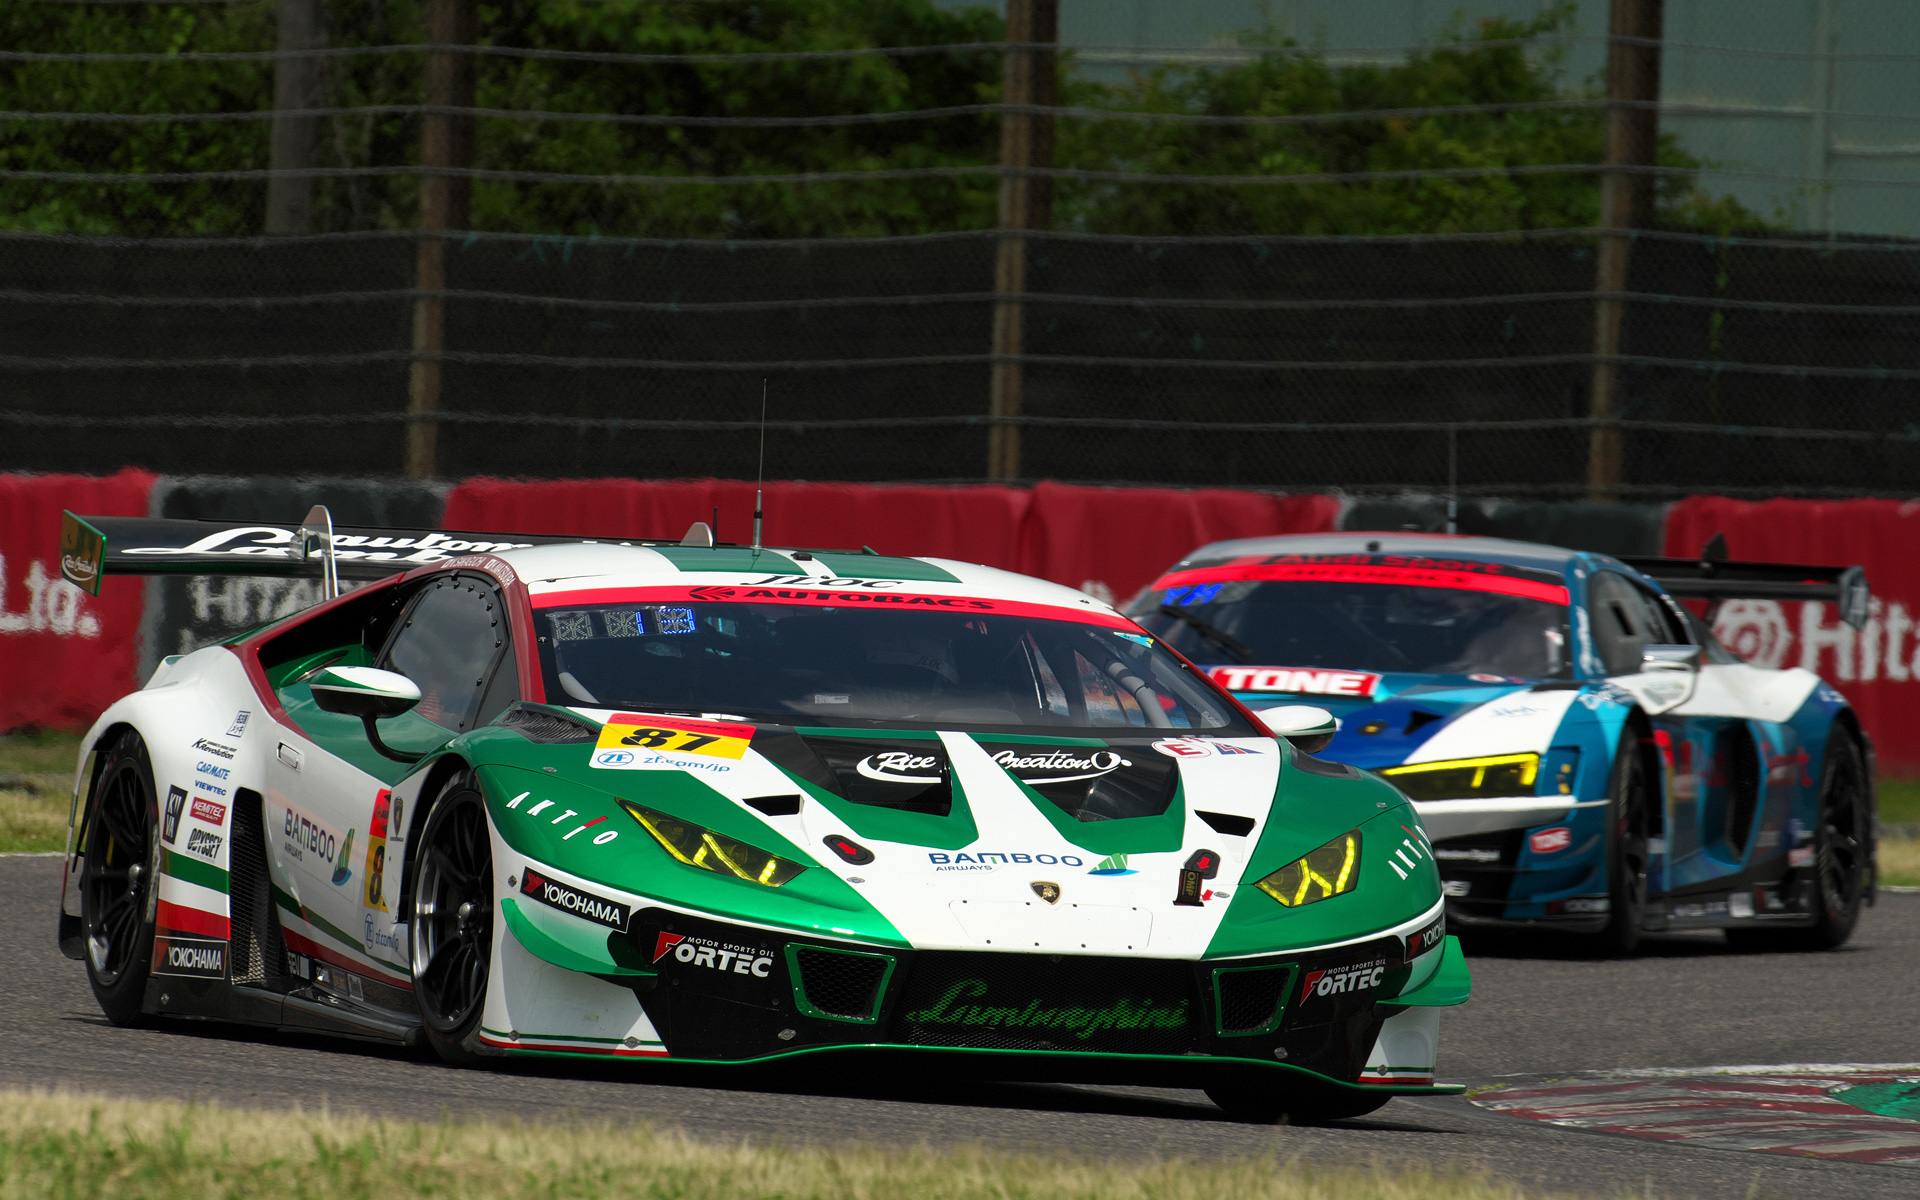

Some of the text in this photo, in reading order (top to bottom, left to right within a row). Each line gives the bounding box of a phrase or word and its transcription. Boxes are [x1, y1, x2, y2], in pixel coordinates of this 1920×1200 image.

[740, 575, 903, 588] JLOC
[743, 590, 996, 610] AUTOBACS
[1222, 668, 1366, 696] TONE
[620, 728, 721, 752] 87
[196, 761, 231, 780] CARMATE
[643, 755, 731, 773] zf.com/jp
[877, 750, 1093, 773] Rice Creation
[194, 780, 227, 796] VIEWTEC
[193, 800, 225, 818] KEMITEC
[506, 791, 619, 845] AKTIO
[187, 828, 223, 860] ODYSSEY
[284, 807, 335, 864] BAMBOO
[928, 852, 1084, 867] BAMBOO
[1186, 871, 1197, 897] OMP
[543, 882, 621, 925] YOKOHAMA
[168, 946, 222, 971] YOKOHAMA
[653, 931, 773, 978] FORTEC
[687, 936, 775, 958] MOTOR SPORTS OIL
[1327, 966, 1350, 975] MOTOR
[1351, 961, 1374, 971] SPORTS
[1300, 966, 1385, 1007] FORTEC
